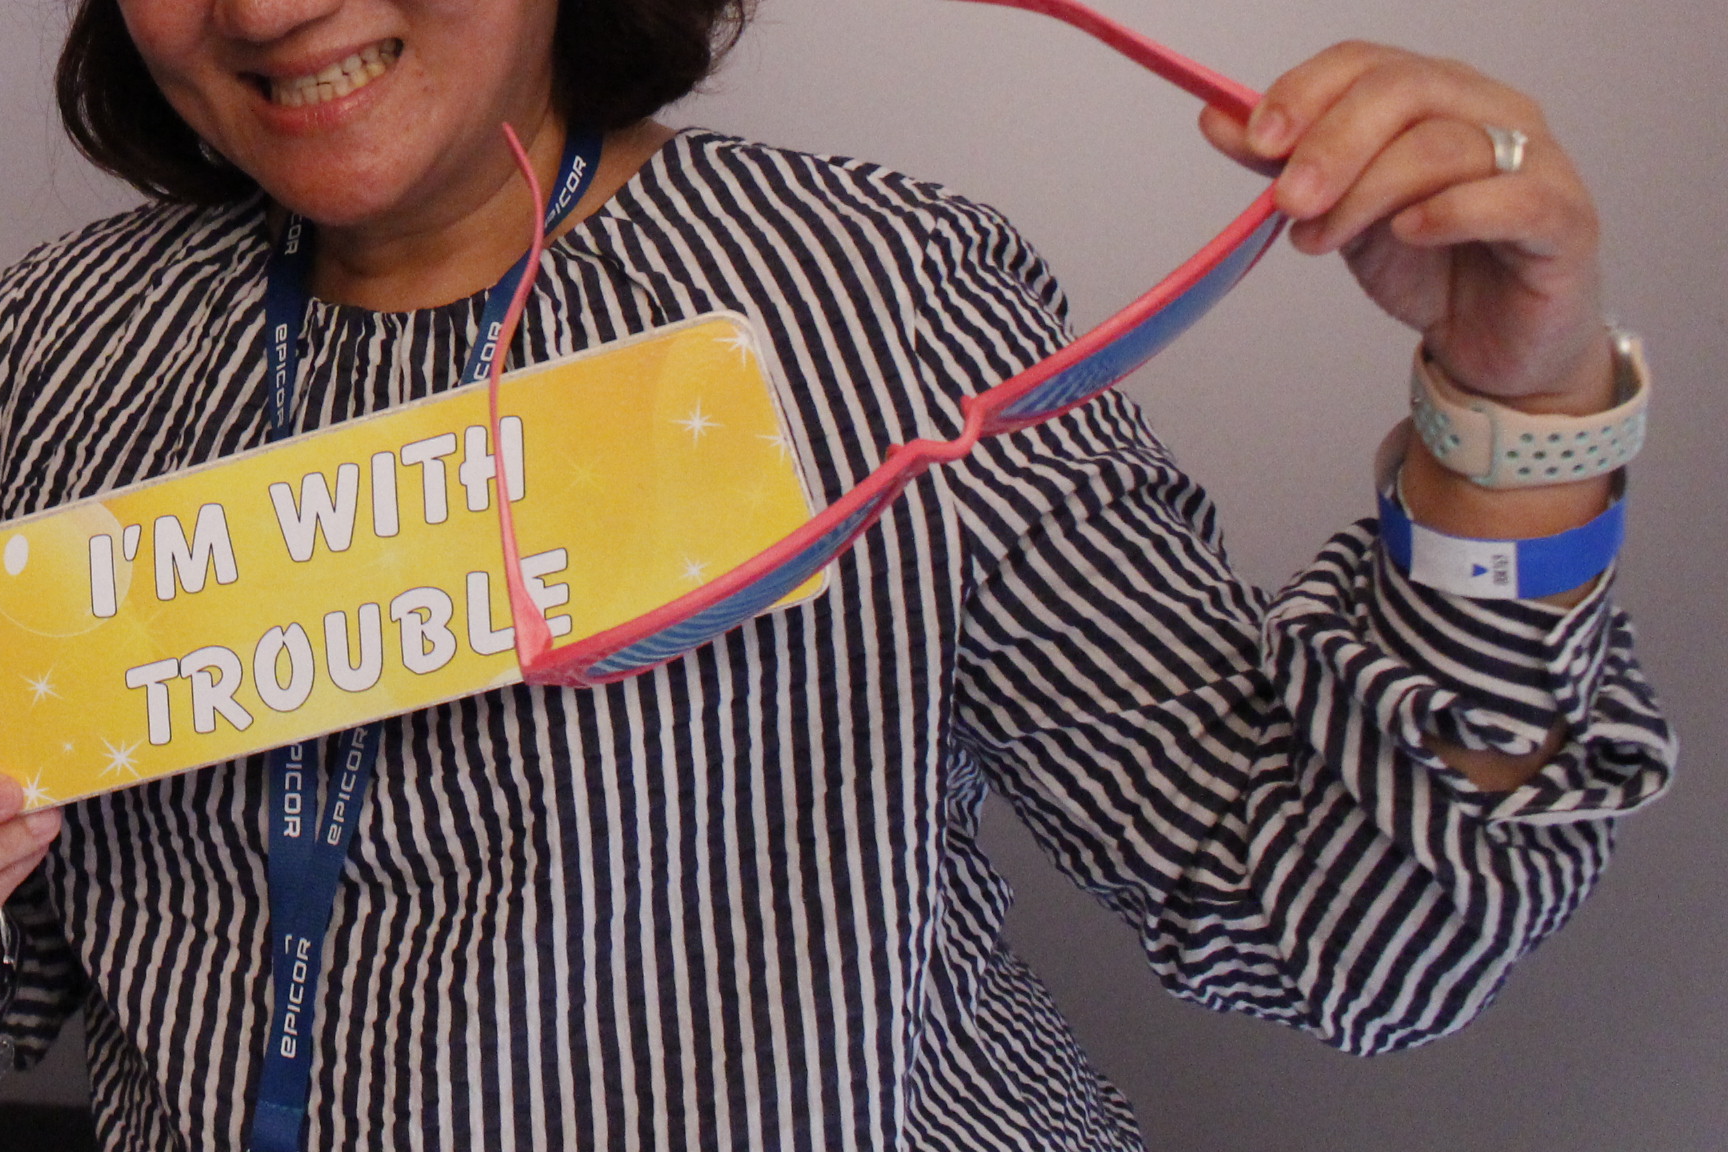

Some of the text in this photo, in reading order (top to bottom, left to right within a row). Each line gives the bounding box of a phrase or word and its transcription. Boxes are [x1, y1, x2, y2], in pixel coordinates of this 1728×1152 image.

[89, 416, 525, 618] I'M WITH
[125, 548, 572, 746] TROUBLE
